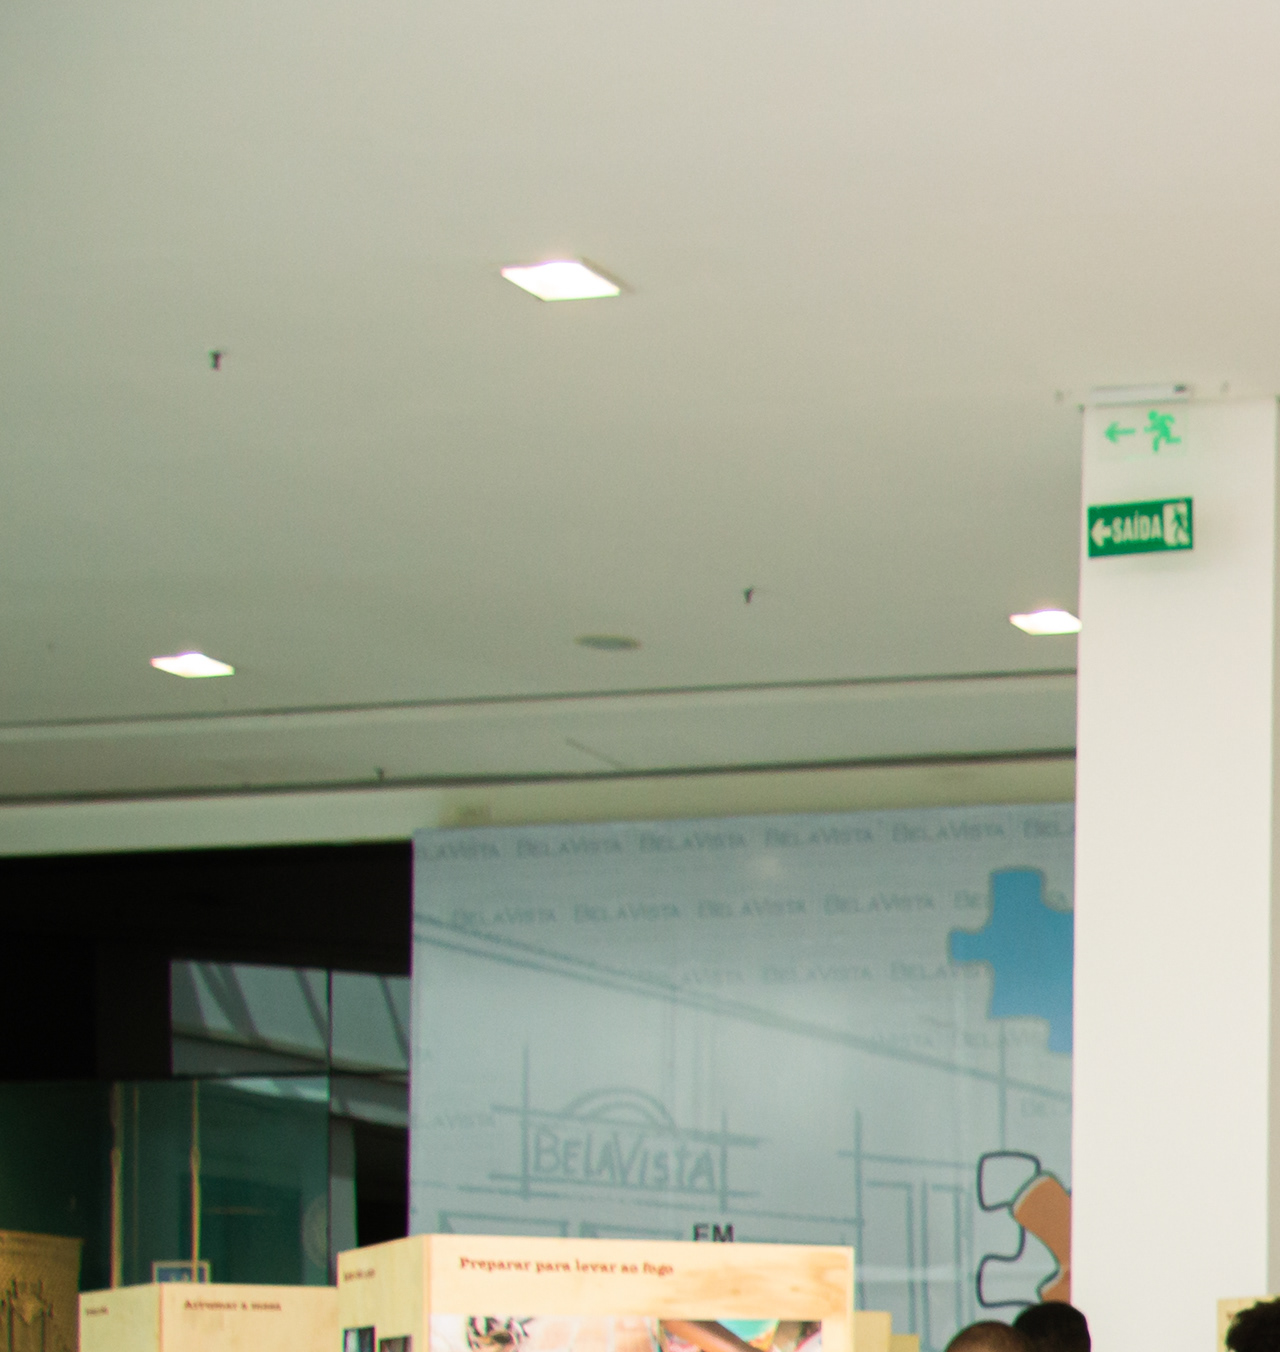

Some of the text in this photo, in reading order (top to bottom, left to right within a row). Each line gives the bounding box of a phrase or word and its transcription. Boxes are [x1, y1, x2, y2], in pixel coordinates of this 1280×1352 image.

[1112, 511, 1162, 545] SAÍDA
[691, 1221, 735, 1242] EM
[459, 1256, 675, 1277] Preparar para levar ao fogo
